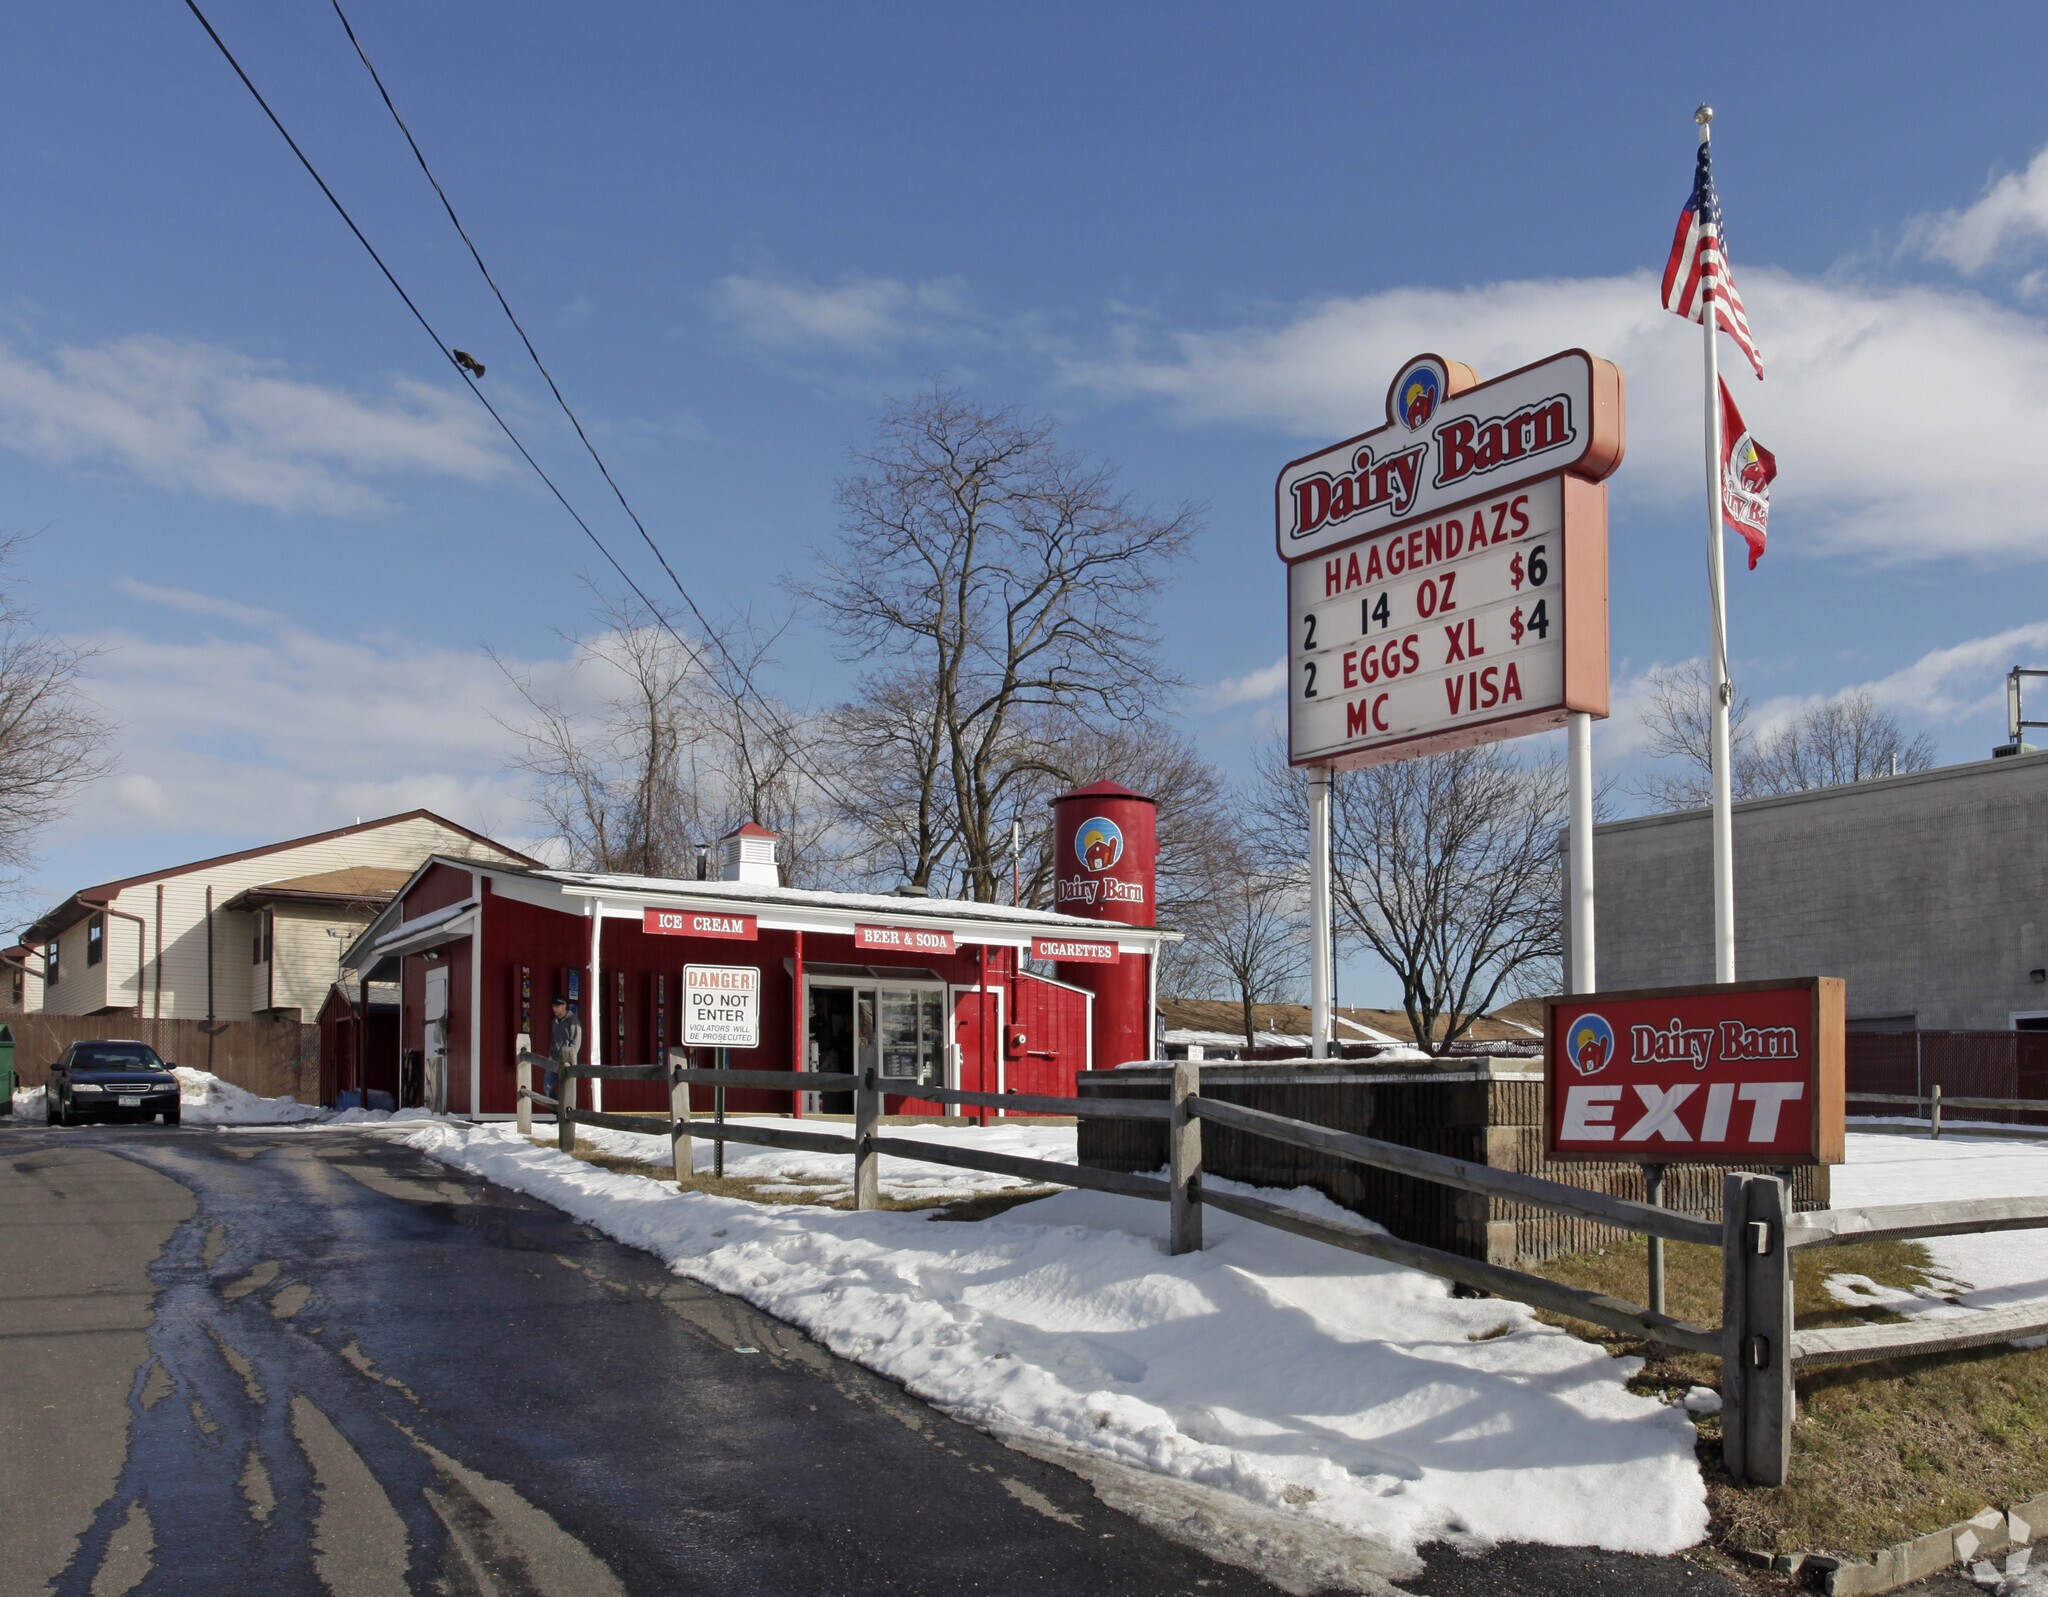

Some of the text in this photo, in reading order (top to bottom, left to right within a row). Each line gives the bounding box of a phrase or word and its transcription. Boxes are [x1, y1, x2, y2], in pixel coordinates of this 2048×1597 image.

[1291, 394, 1576, 538] Dairy Barn
[1325, 494, 1530, 597] HAAGENDAZS
[1303, 544, 1548, 651] 2 14 OZ $6
[1303, 598, 1549, 699] 2 EGGS XL $4
[1346, 661, 1523, 738] MC VISA
[1058, 875, 1144, 904] Dairy Barn
[658, 913, 743, 933] ICE CREAM
[864, 929, 947, 948] BEER & SODA
[1040, 942, 1112, 958] CIGARETTES
[688, 971, 755, 989] DANGER!
[693, 993, 749, 1007] DO NOT
[697, 1008, 744, 1022] ENTER
[689, 1024, 750, 1033] VIOLATORS WILL
[689, 1032, 752, 1041] BE PROSECUTED
[1630, 1016, 1799, 1071] Dairy Barn
[1560, 1081, 1804, 1142] EXIT
